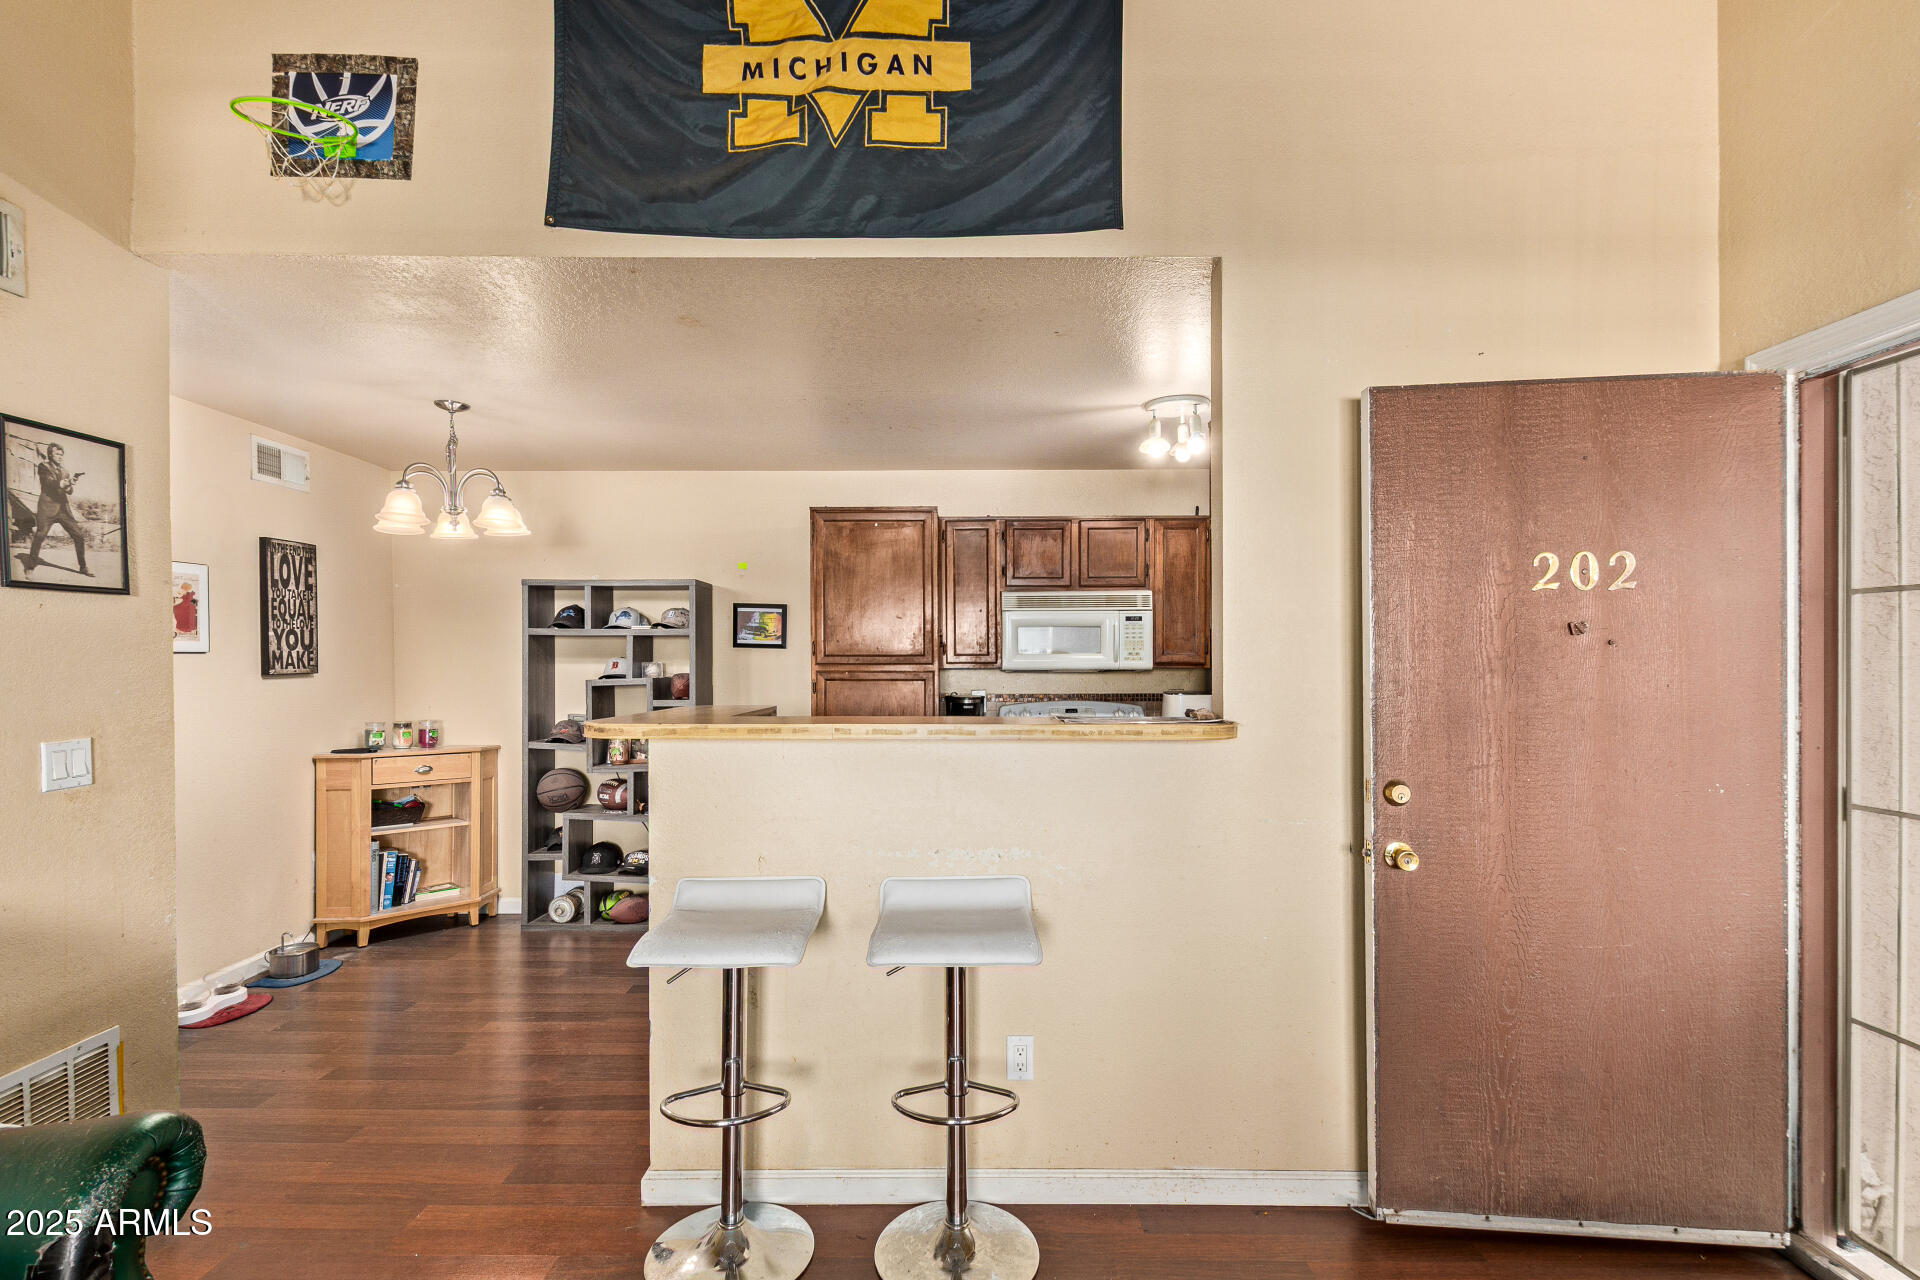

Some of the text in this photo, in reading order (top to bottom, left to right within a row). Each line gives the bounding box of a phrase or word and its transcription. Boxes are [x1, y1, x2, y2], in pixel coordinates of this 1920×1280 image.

[741, 51, 933, 82] MICHIGAN
[310, 98, 368, 120] NERF
[289, 545, 302, 556] END
[270, 552, 314, 591] LOVE
[1531, 550, 1637, 591] 202
[271, 587, 314, 601] YOU TAKE IS
[271, 597, 314, 621] EQUAL
[271, 619, 314, 630] TO THE LOVE
[271, 628, 314, 651] YOU
[271, 650, 315, 669] MAKE
